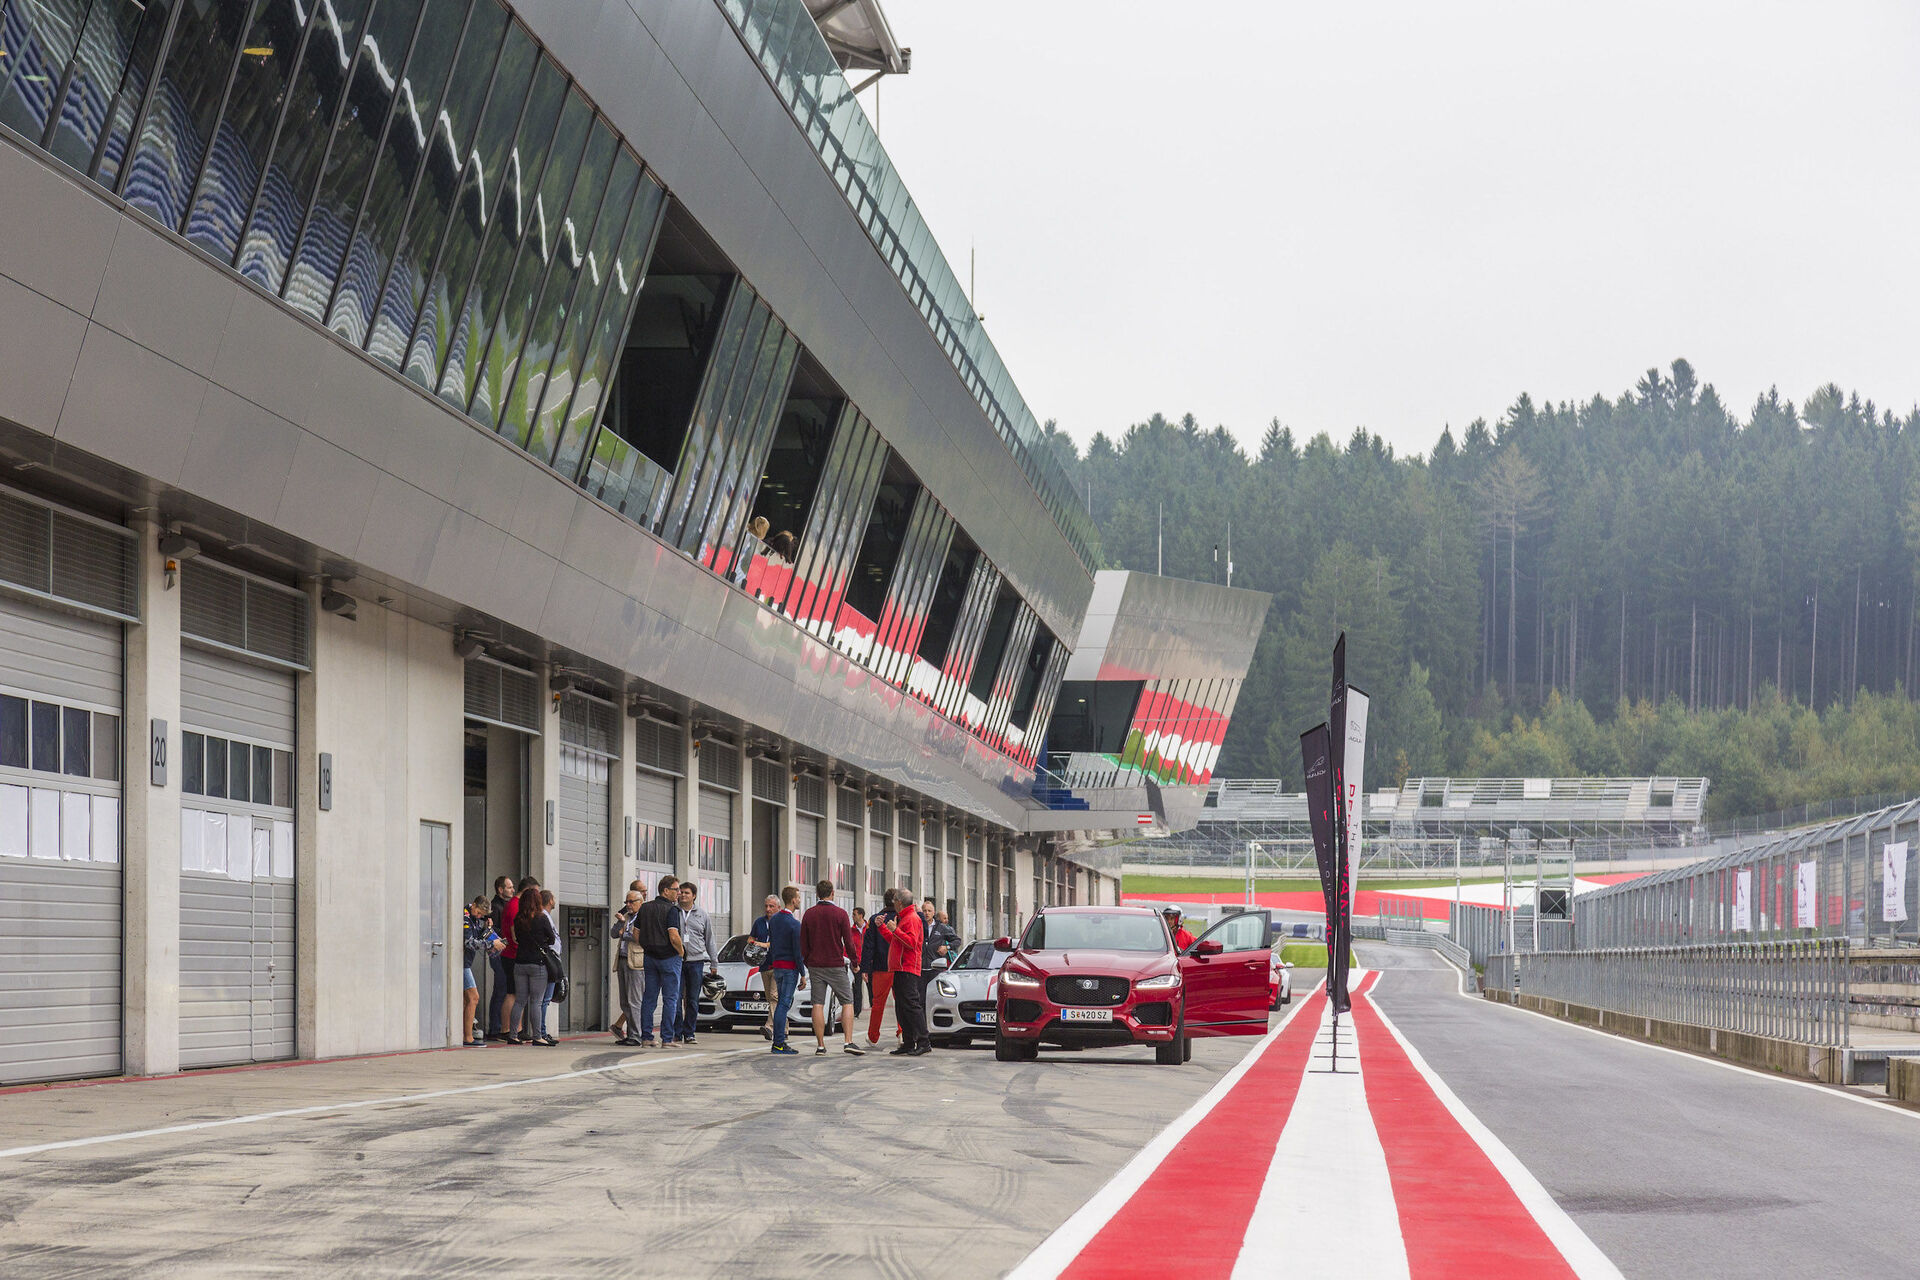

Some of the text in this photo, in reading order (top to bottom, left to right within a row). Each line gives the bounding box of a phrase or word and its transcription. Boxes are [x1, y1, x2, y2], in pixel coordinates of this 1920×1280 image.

[154, 737, 166, 768] 20
[322, 767, 330, 794] 19
[1070, 1011, 1107, 1019] S 420 SZ
